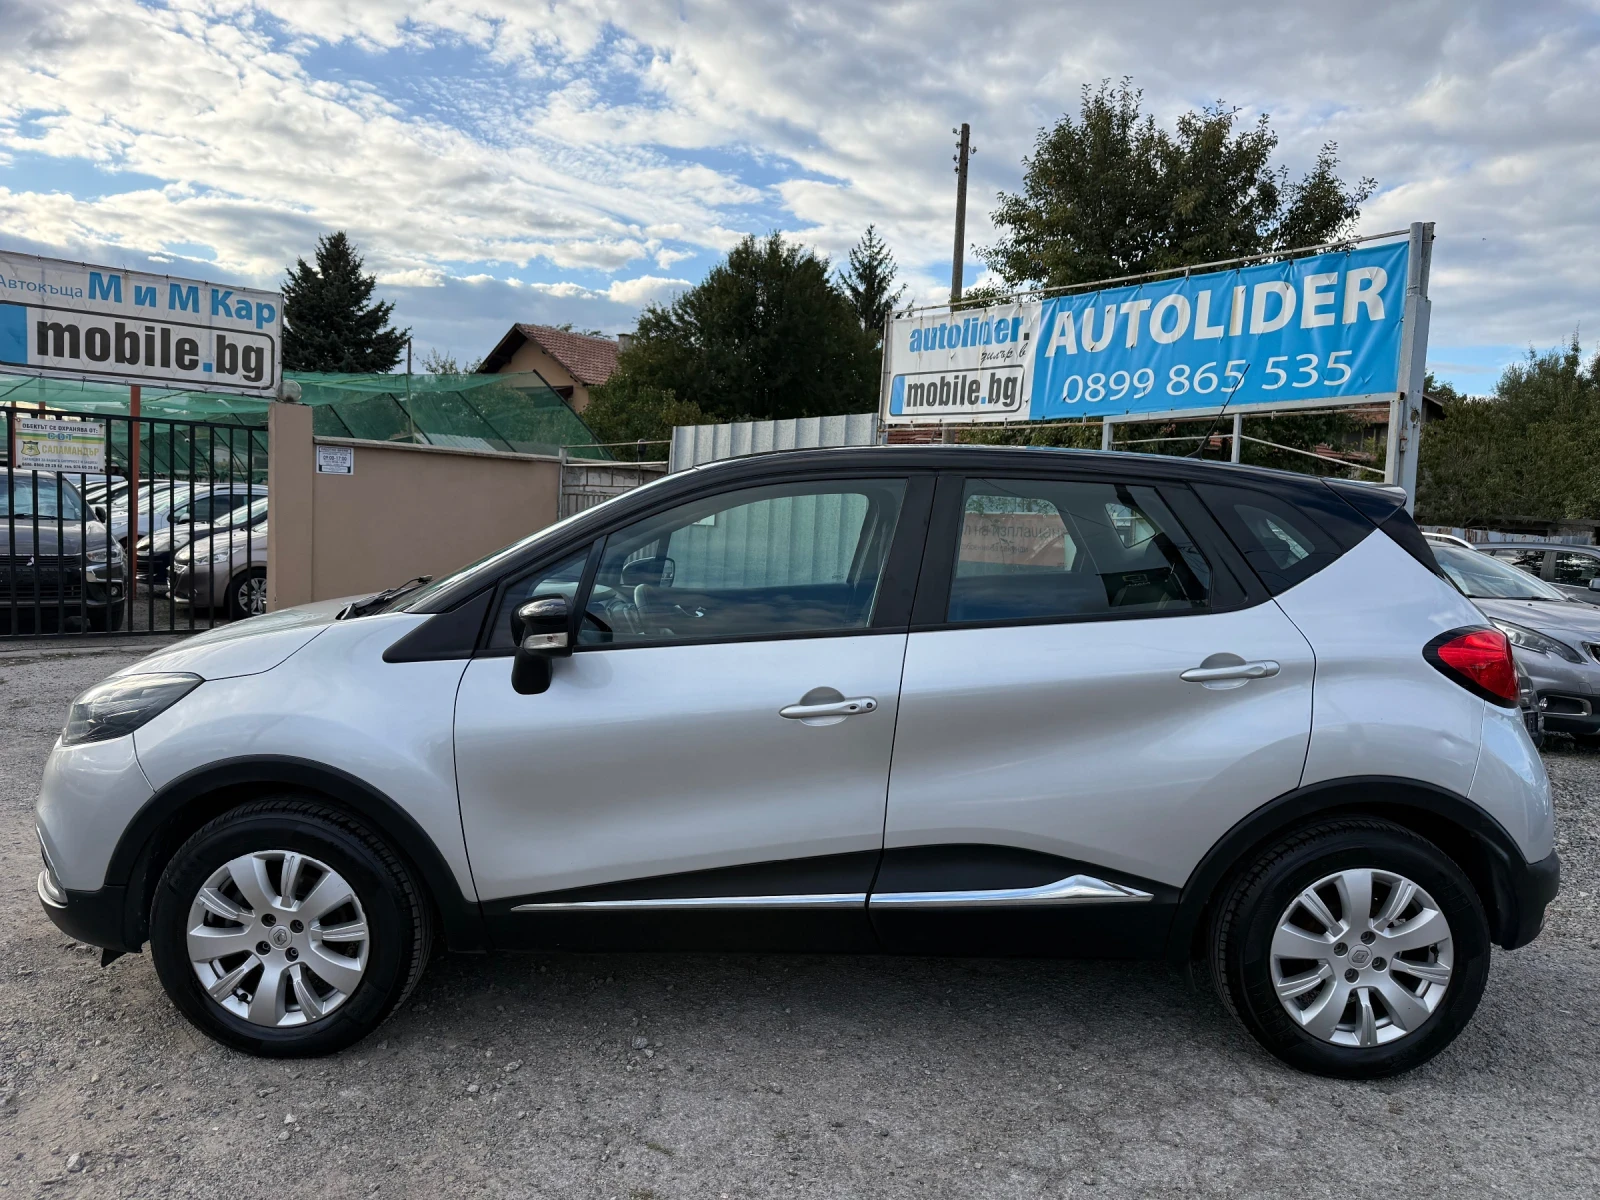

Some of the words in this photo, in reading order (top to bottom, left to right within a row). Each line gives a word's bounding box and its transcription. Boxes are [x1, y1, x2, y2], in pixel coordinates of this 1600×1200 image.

[88, 271, 122, 303] М
[134, 285, 157, 308] и
[168, 283, 200, 313] М
[211, 288, 276, 329] Кар
[1044, 266, 1388, 357] AUTOLIDER
[37, 320, 264, 382] mobile.bg
[1062, 368, 1155, 404] 0899
[1166, 359, 1247, 396] 865
[1261, 350, 1353, 390] 535
[906, 372, 1018, 408] mobile.bg
[41, 444, 99, 457] САЛАМАНДЪР
[58, 425, 88, 433] ОХРАНЯВА
